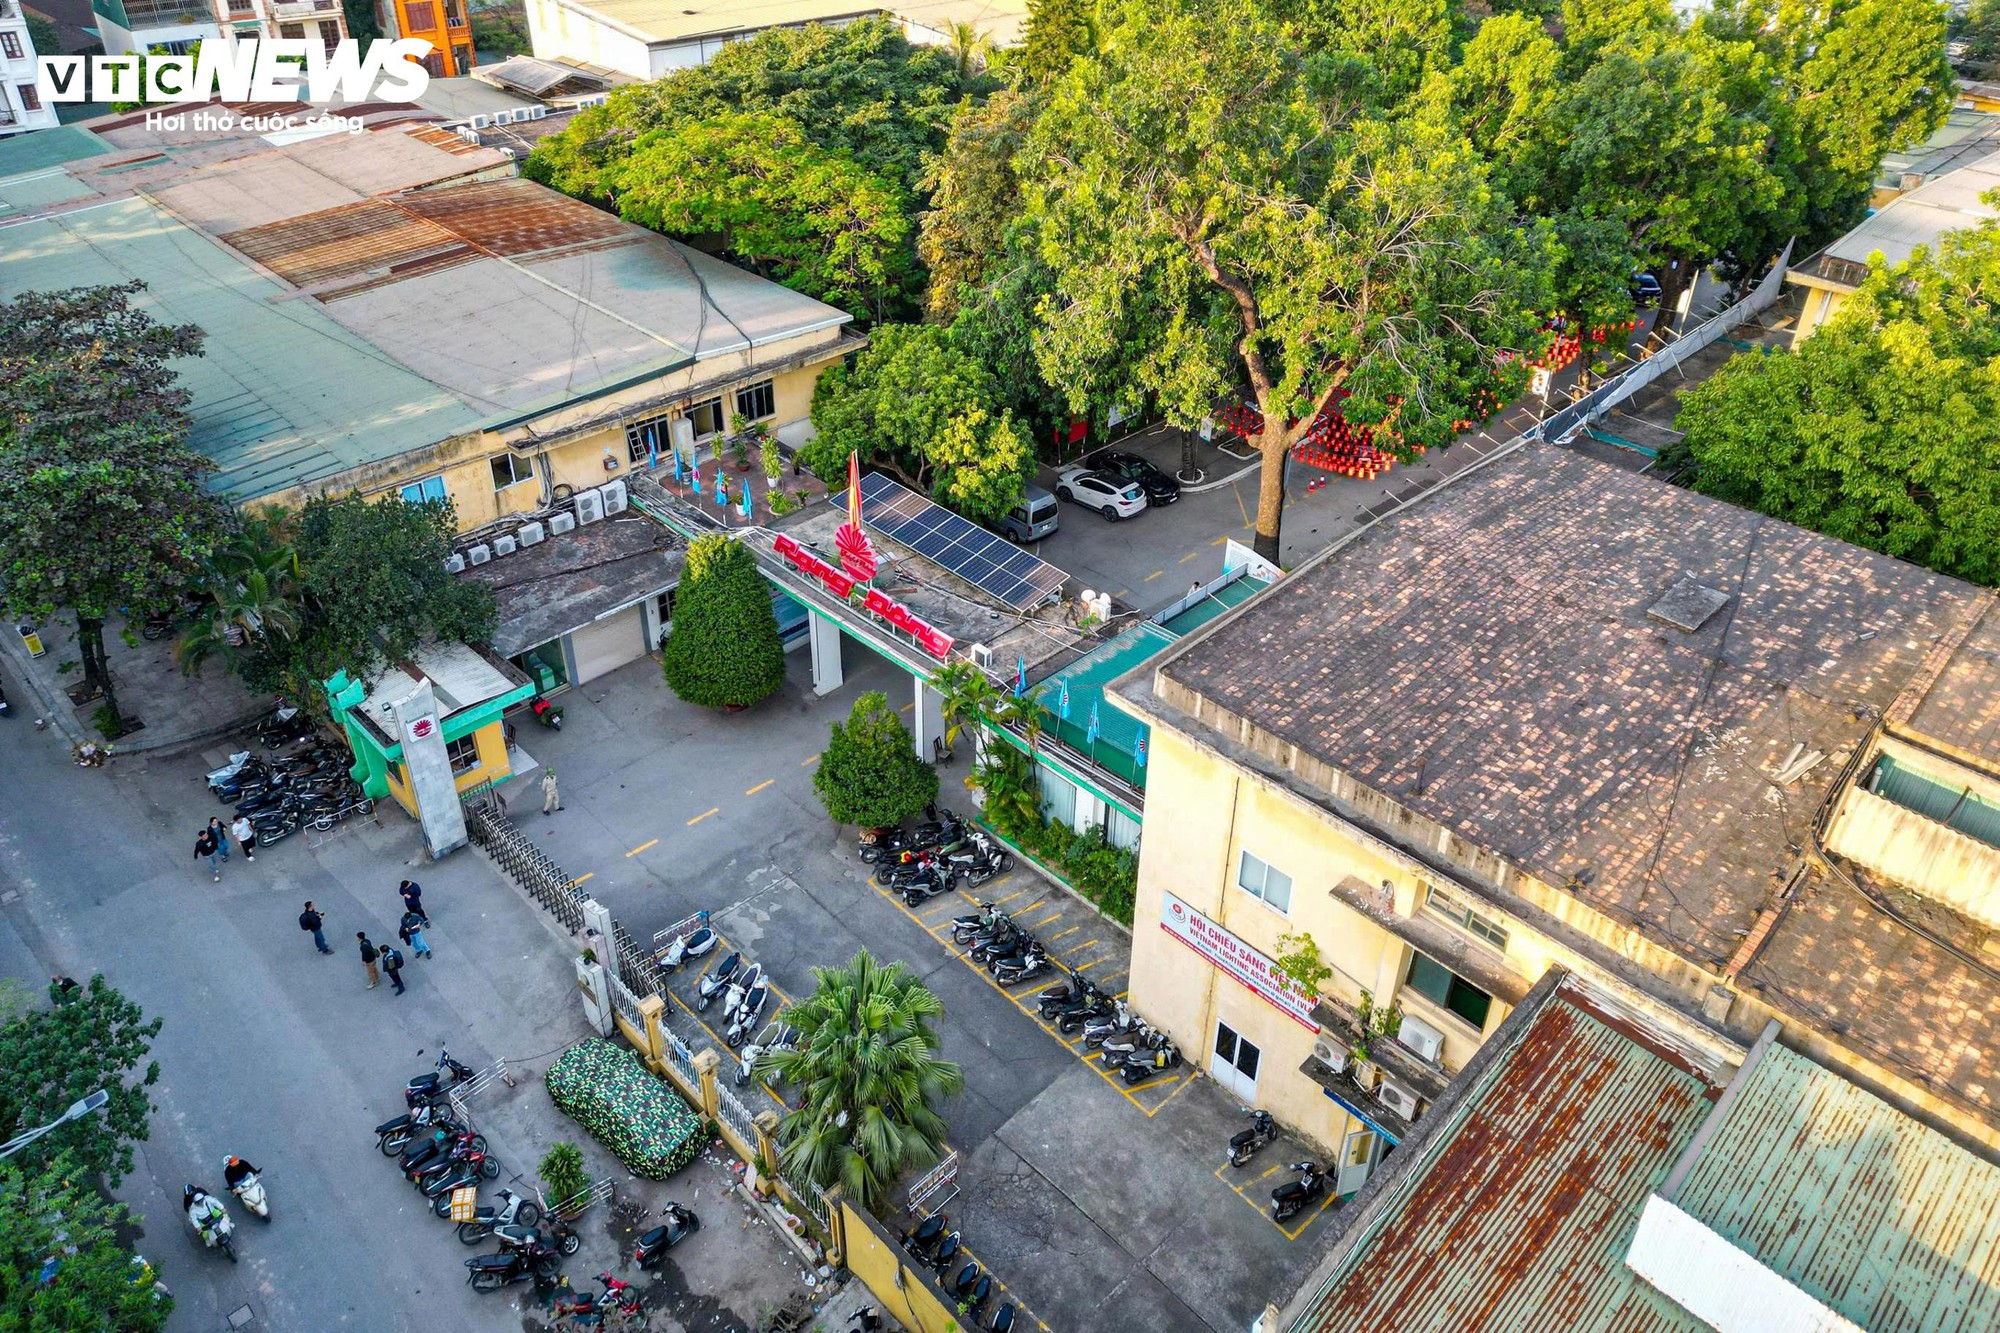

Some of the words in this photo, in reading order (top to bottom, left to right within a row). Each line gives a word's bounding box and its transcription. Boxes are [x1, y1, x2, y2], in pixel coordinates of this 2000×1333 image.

[1189, 927, 1218, 951] VIETNAM
[1219, 947, 1249, 972] LIGHTING
[1250, 969, 1296, 1003] ASSOCIATION
[1190, 914, 1206, 933] HỘI
[1208, 926, 1237, 953] CHIẾU
[1239, 948, 1267, 973] SÁNG
